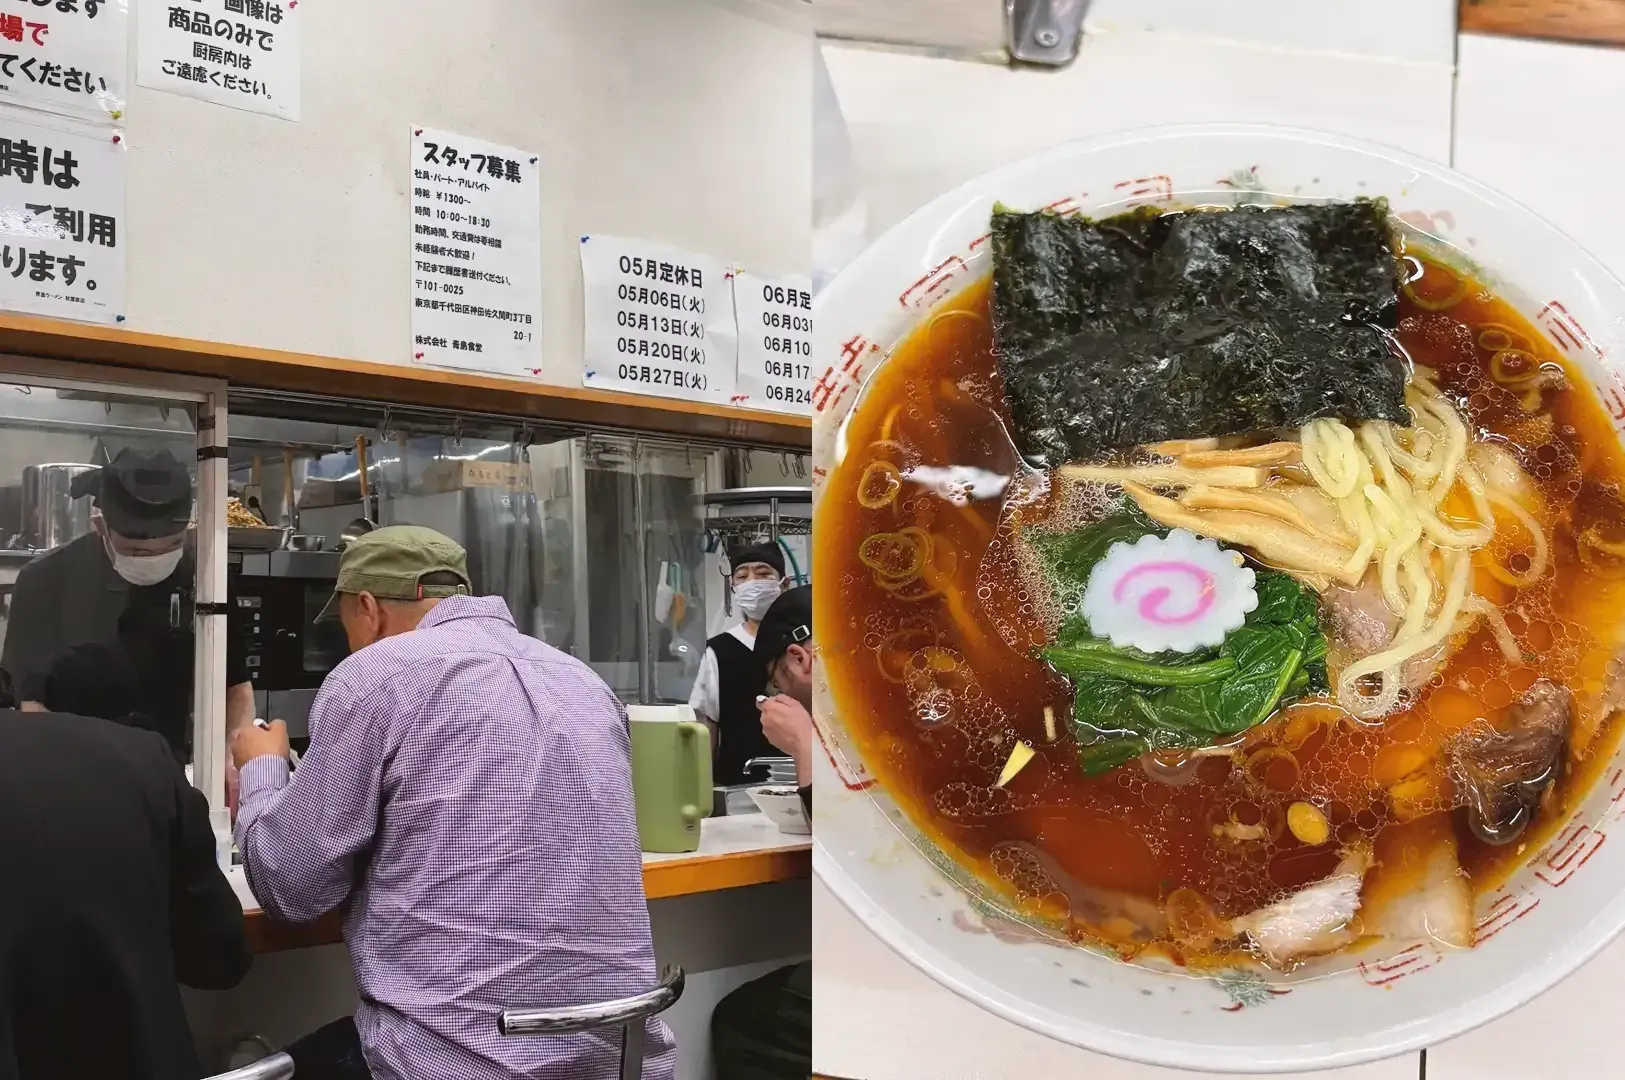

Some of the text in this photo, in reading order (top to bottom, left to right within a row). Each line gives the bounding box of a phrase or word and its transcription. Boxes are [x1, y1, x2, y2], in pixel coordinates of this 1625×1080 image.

[168, 6, 274, 51] 商品のみで
[193, 41, 252, 70] 厨房内は
[0, 53, 107, 94] てください
[161, 59, 272, 99] ご遠慮ください。
[423, 142, 521, 184] スタッフ募集
[414, 205, 430, 217] 時間
[0, 245, 97, 290] ります。
[619, 255, 703, 288] 05月定休日
[762, 312, 812, 334] 06月03
[415, 335, 448, 348] 株式会社
[764, 336, 812, 356] 06月10
[765, 360, 812, 380] 06月17
